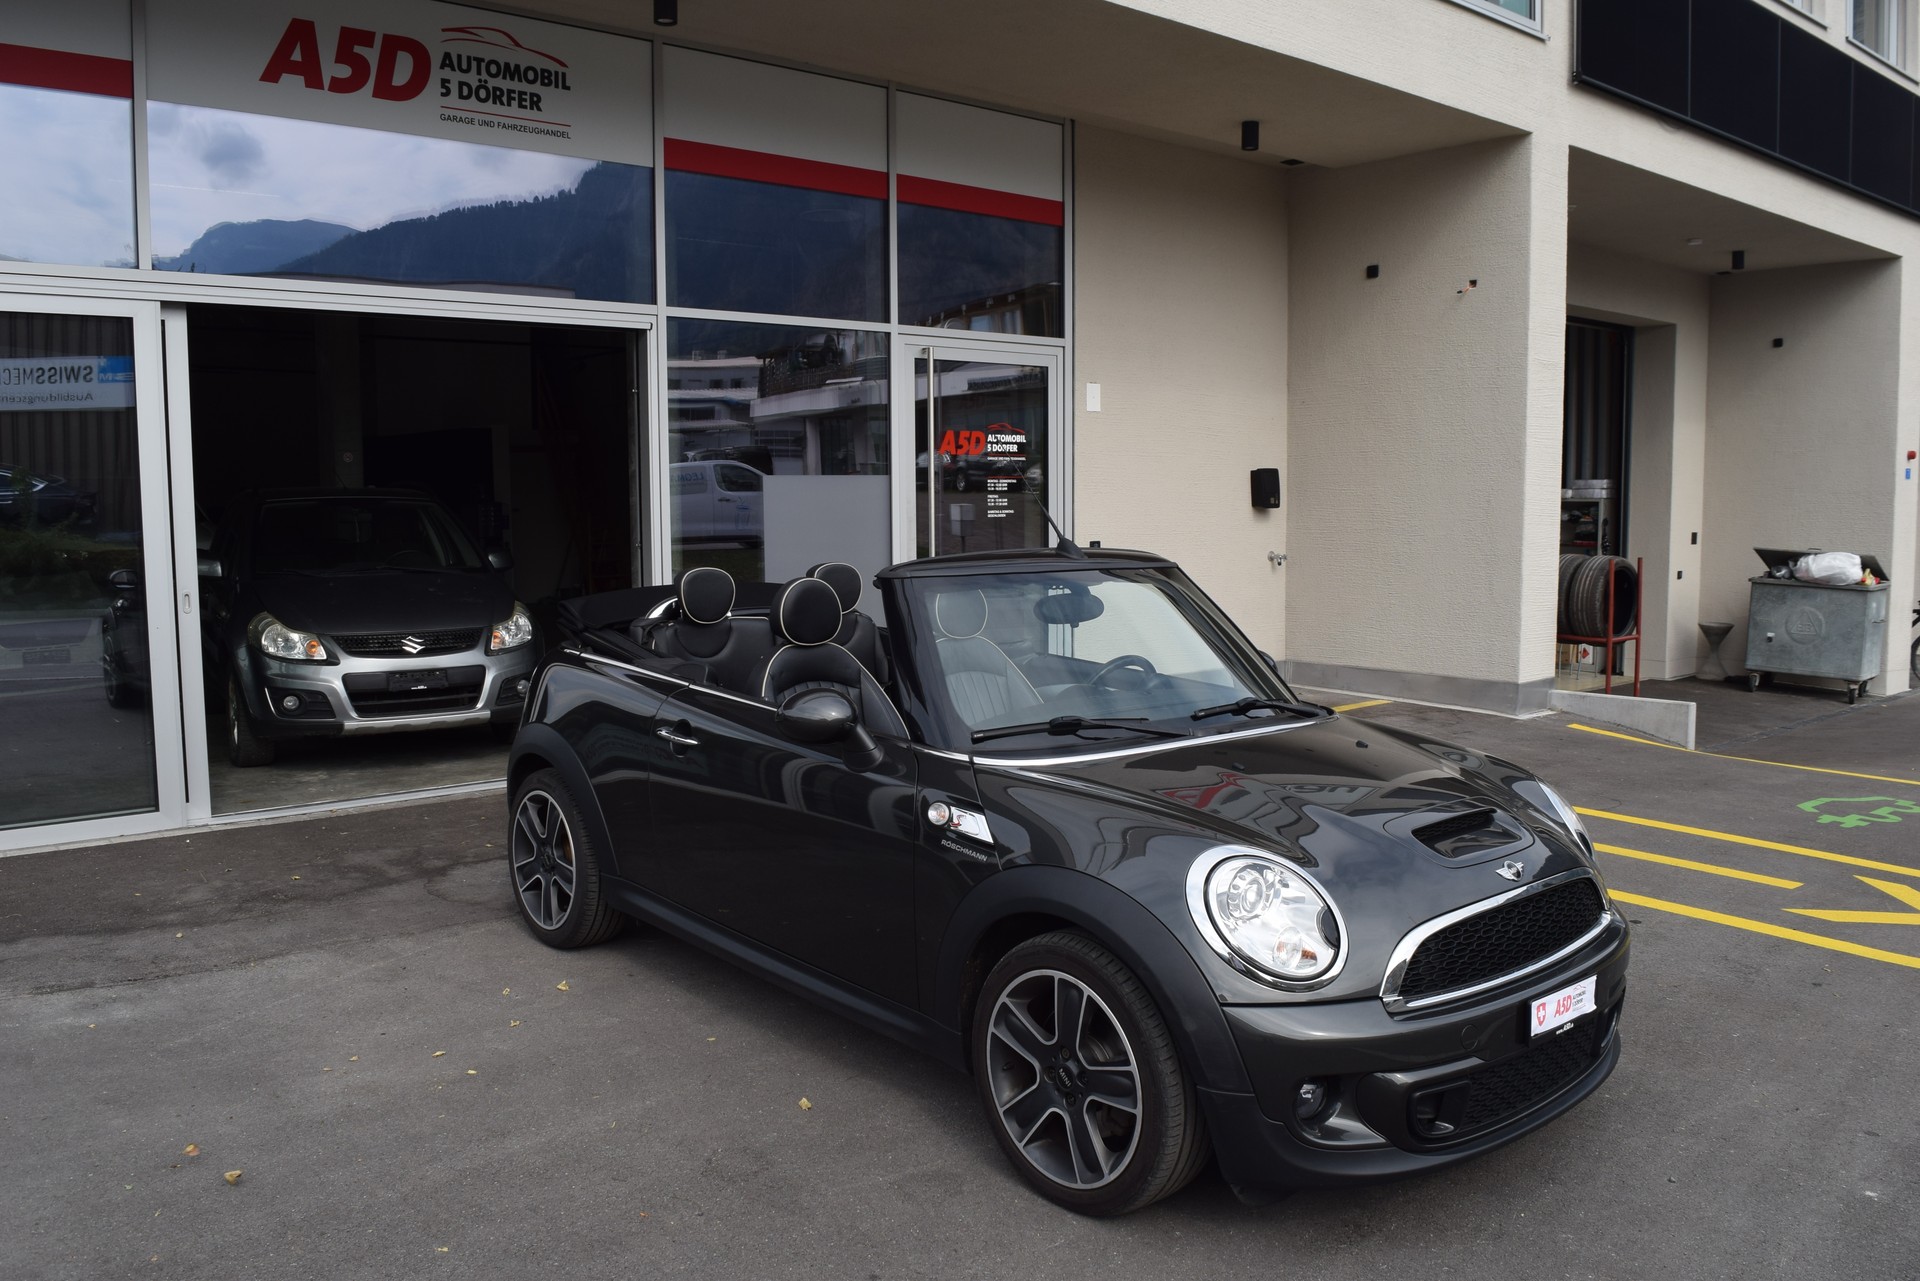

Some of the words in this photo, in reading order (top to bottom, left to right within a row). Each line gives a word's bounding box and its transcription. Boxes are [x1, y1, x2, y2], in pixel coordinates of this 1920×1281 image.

[258, 17, 431, 102] A5D
[439, 51, 571, 91] AUTOMOBIL
[440, 77, 451, 97] 5
[457, 78, 543, 112] DÖRFER
[439, 113, 476, 126] GARAGE
[478, 117, 495, 129] UND
[497, 121, 571, 140] FAHRZEUGHANDEL
[938, 430, 986, 456] A5D
[987, 434, 1026, 443] AUTOMOBIL
[987, 444, 992, 452] 5
[941, 839, 987, 861] RÖSCHMANN
[1553, 994, 1573, 1018] A5D
[1058, 1068, 1072, 1086] MINI
